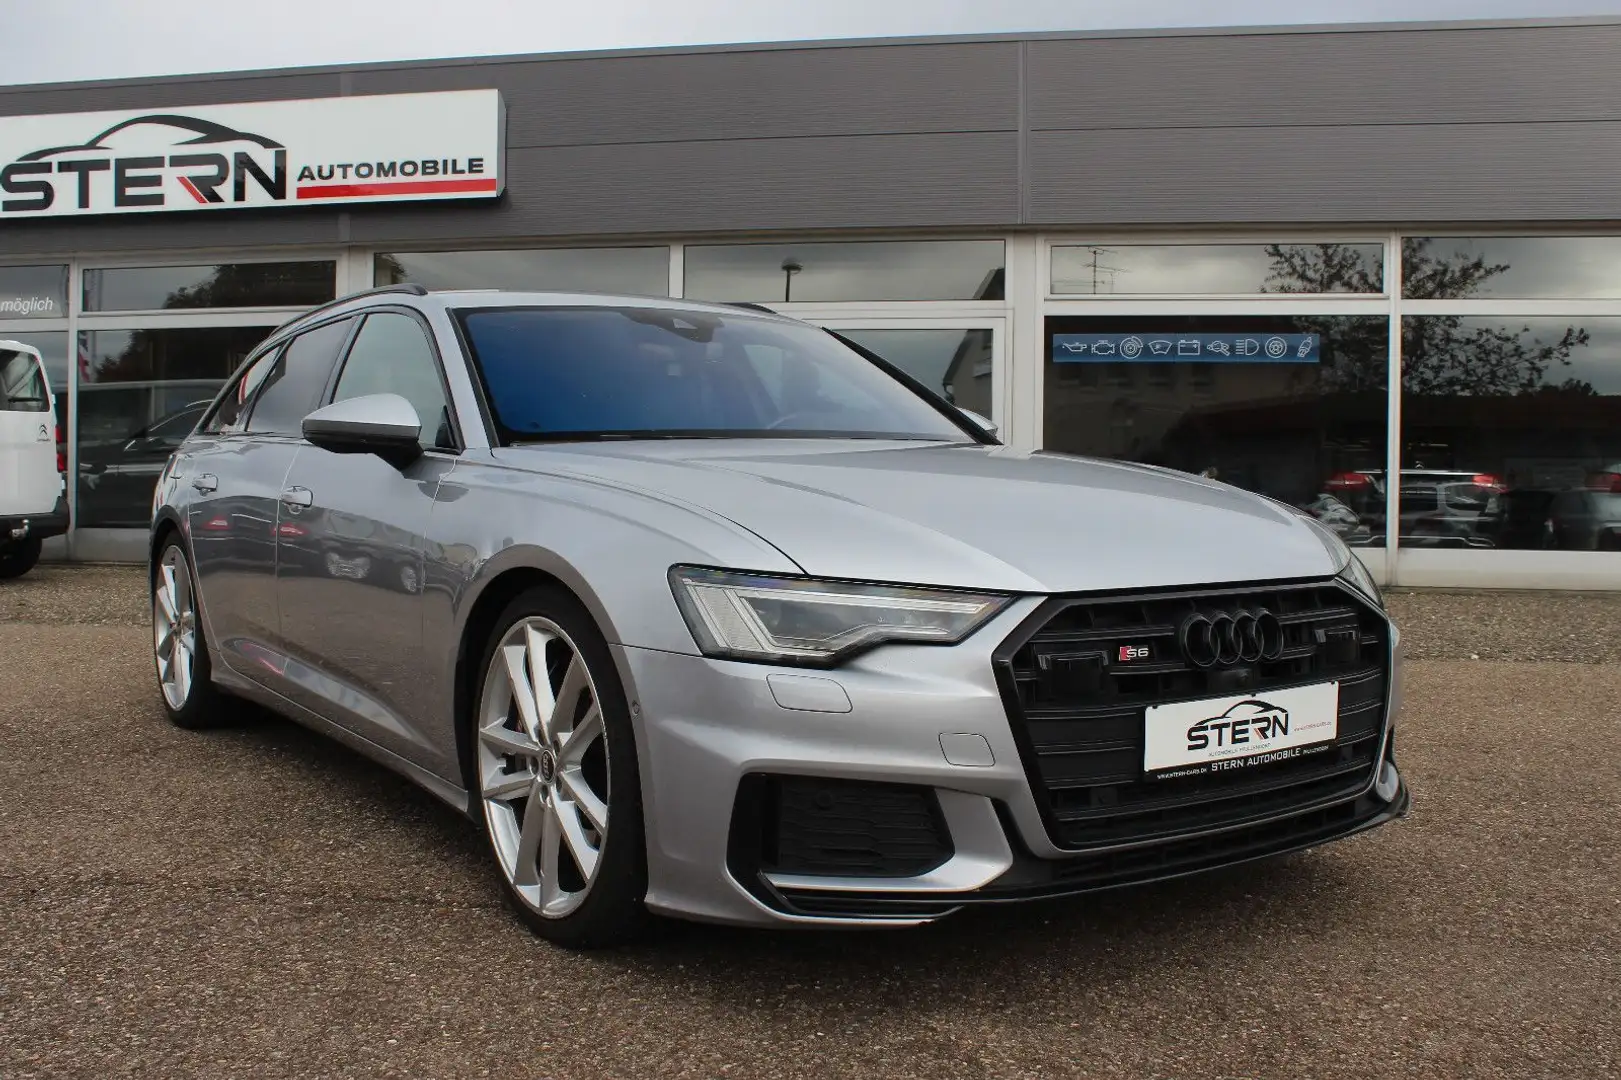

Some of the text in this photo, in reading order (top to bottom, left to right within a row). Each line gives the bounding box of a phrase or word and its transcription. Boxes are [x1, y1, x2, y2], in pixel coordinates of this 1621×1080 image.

[1, 149, 484, 212] STERN AUTOMOBILE
[0, 296, 53, 315] möglich
[1127, 647, 1149, 658] S6
[1187, 713, 1288, 750] STERN
[1211, 759, 1244, 772] STERN
[1247, 747, 1301, 766] AUTOMOBILE
